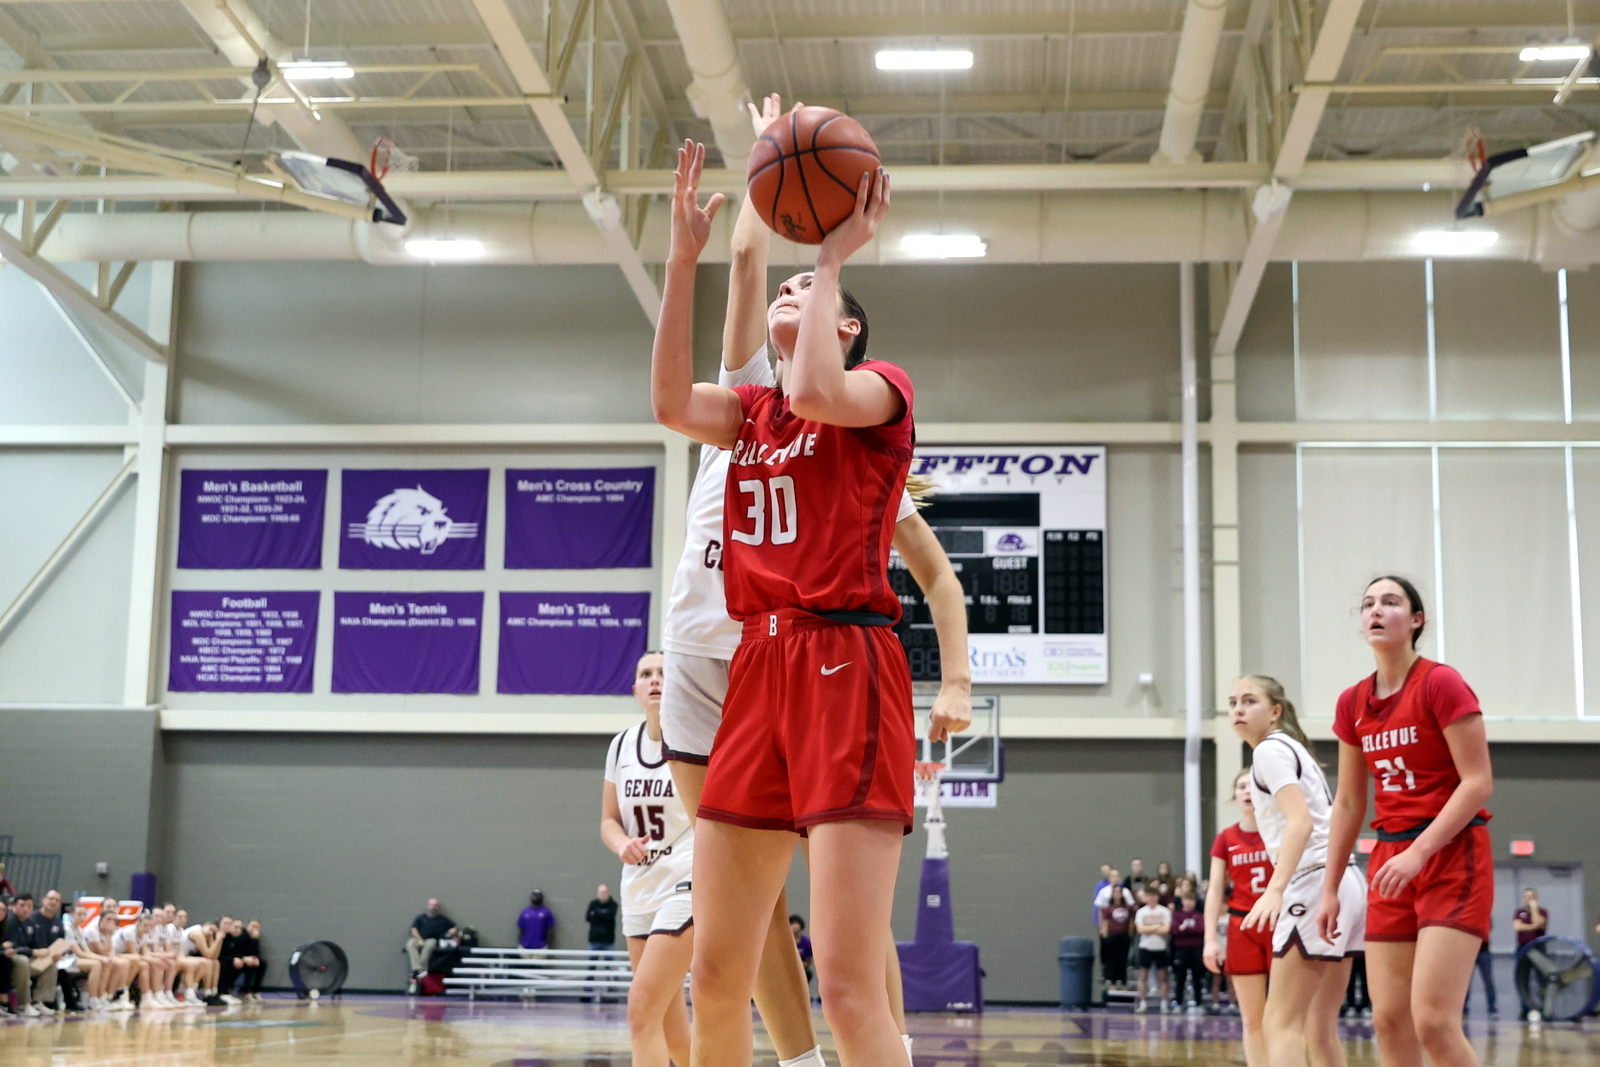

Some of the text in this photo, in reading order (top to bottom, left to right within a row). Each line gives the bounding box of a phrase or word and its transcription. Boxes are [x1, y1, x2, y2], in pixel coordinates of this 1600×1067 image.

[912, 454, 1099, 475] FFTON
[203, 480, 303, 493] Men's Basketball
[517, 479, 643, 493] Men's Cross Country
[731, 475, 797, 546] 30
[992, 557, 1029, 569] GUEST
[221, 597, 268, 609] Football
[369, 602, 448, 615] Men's Tennis
[538, 602, 611, 616] Men's Track
[769, 614, 778, 636] B
[1361, 726, 1419, 753] BELLEVUE
[1374, 756, 1416, 791] 21
[624, 780, 674, 797] GENOA
[633, 805, 665, 841] 15
[1231, 850, 1268, 867] BELLEV
[1250, 867, 1267, 894] 2
[1288, 903, 1307, 917] G
